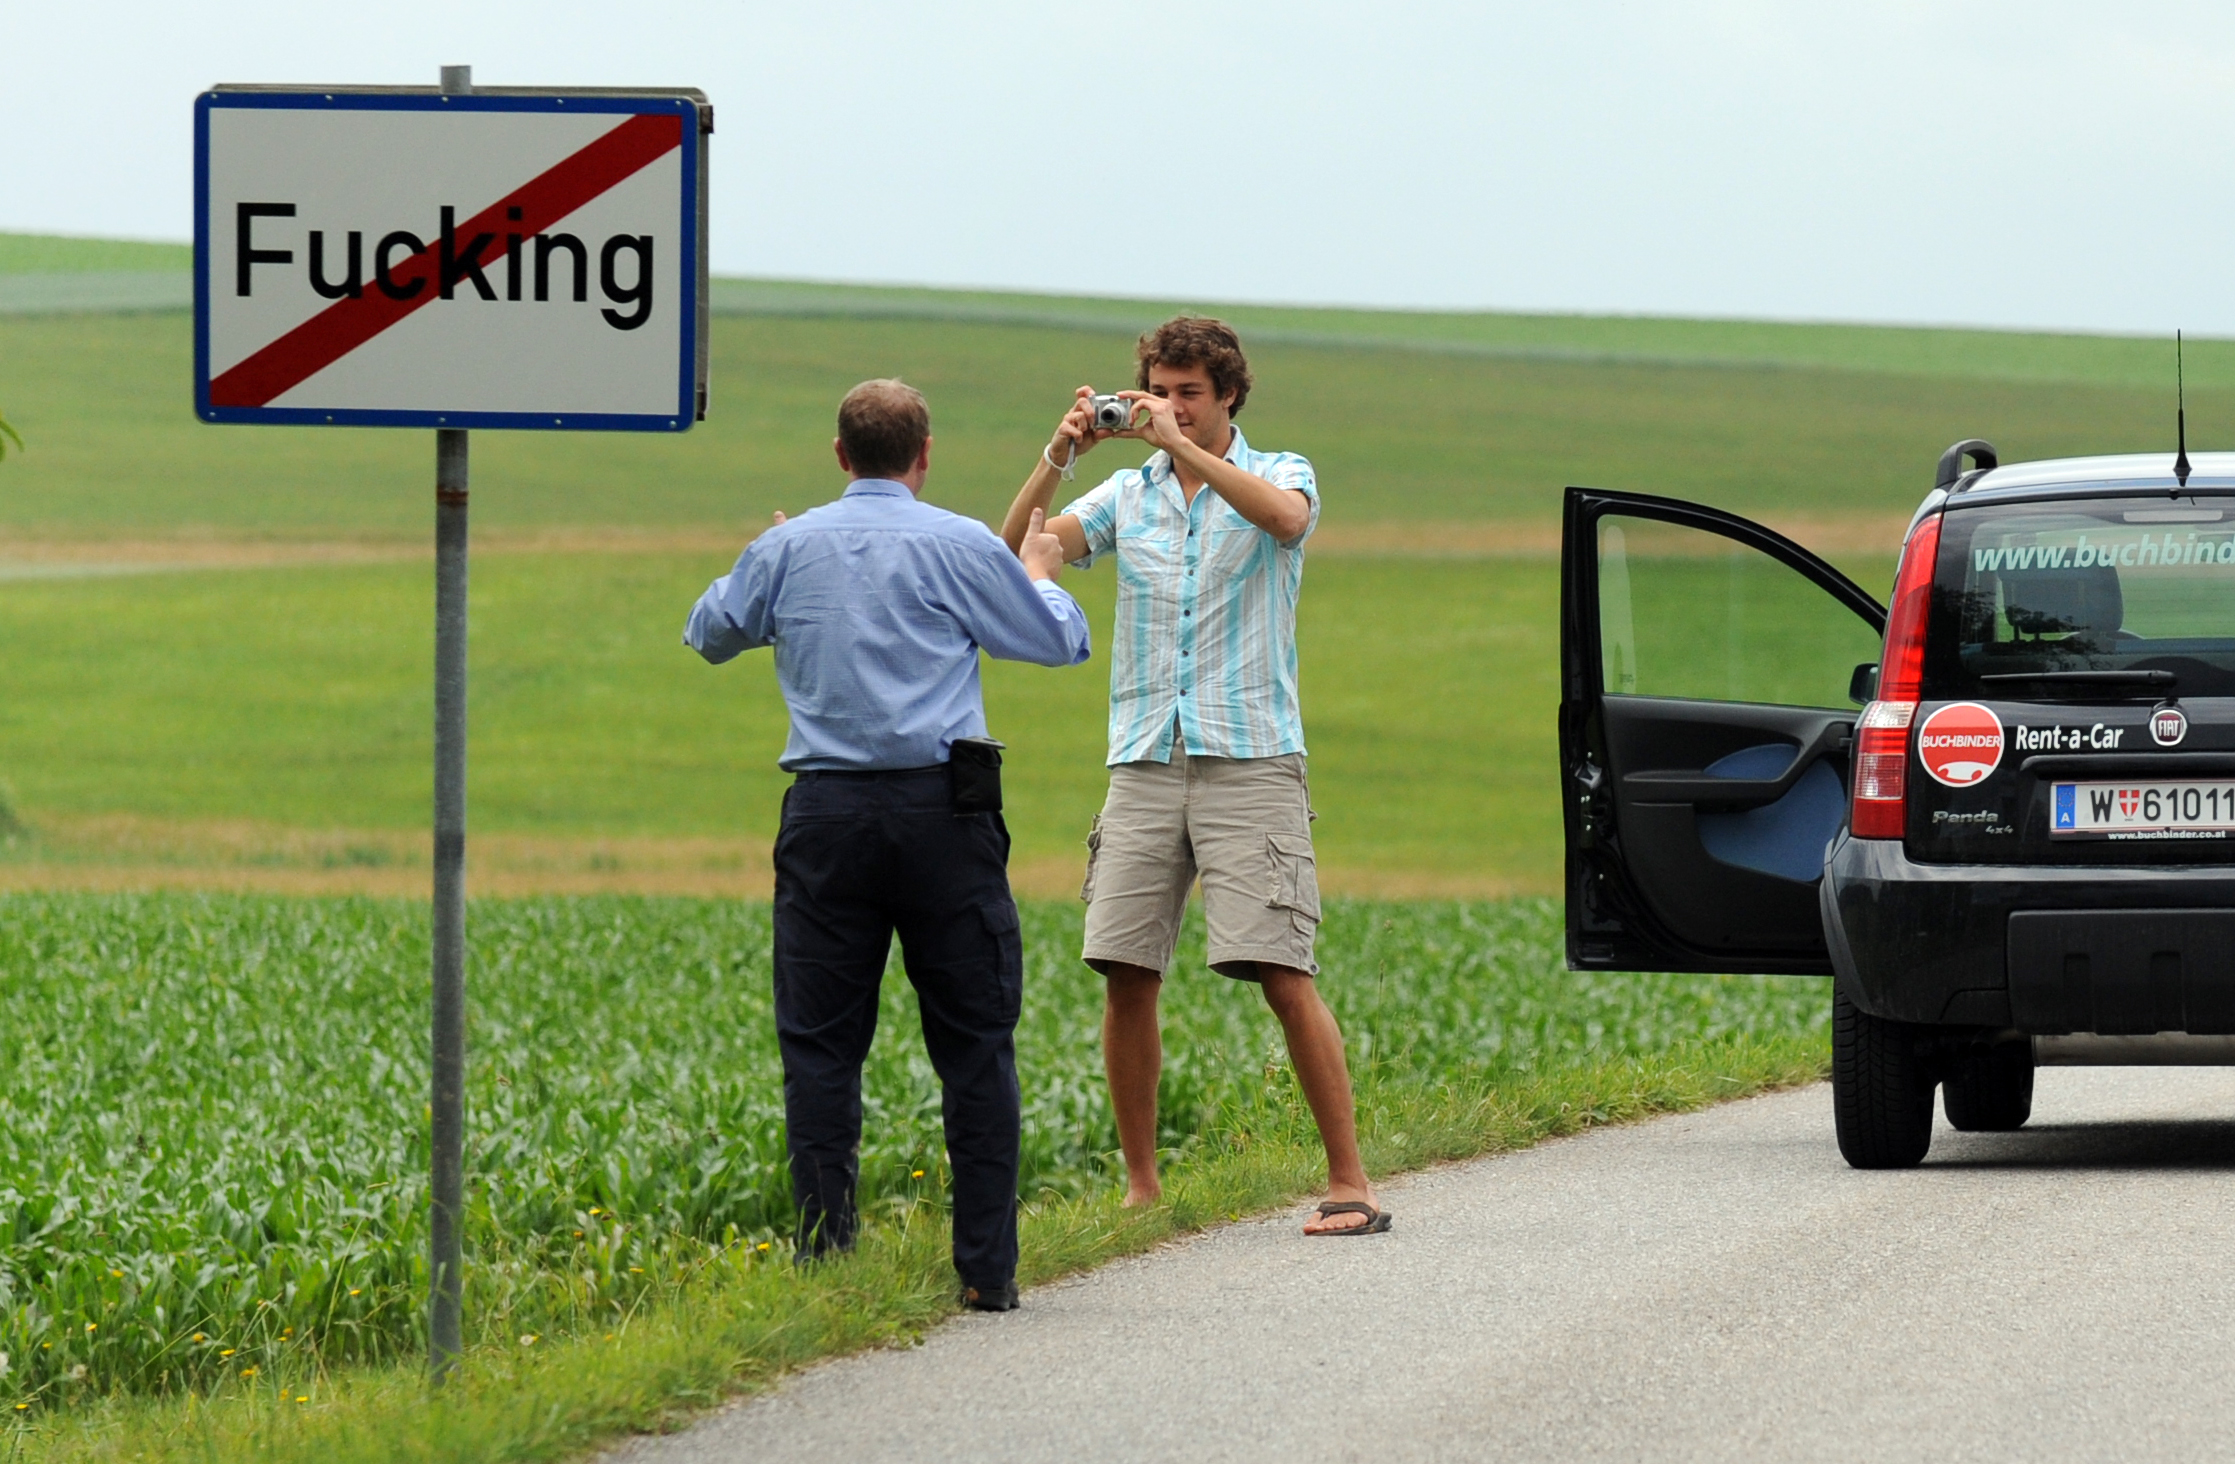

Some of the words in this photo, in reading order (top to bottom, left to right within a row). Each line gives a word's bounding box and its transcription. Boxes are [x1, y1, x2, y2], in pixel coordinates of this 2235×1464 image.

[236, 202, 654, 331] Fucking
[2158, 719, 2180, 737] FIAT
[1922, 735, 2000, 748] BUCHBINDER
[2015, 723, 2124, 750] Rent-a-Car
[2090, 789, 2114, 823] W
[2143, 788, 2234, 821] 61011
[1932, 810, 1998, 823] Panda
[2060, 812, 2071, 823] A
[2108, 830, 2226, 839] www.buchbinder.co.at
